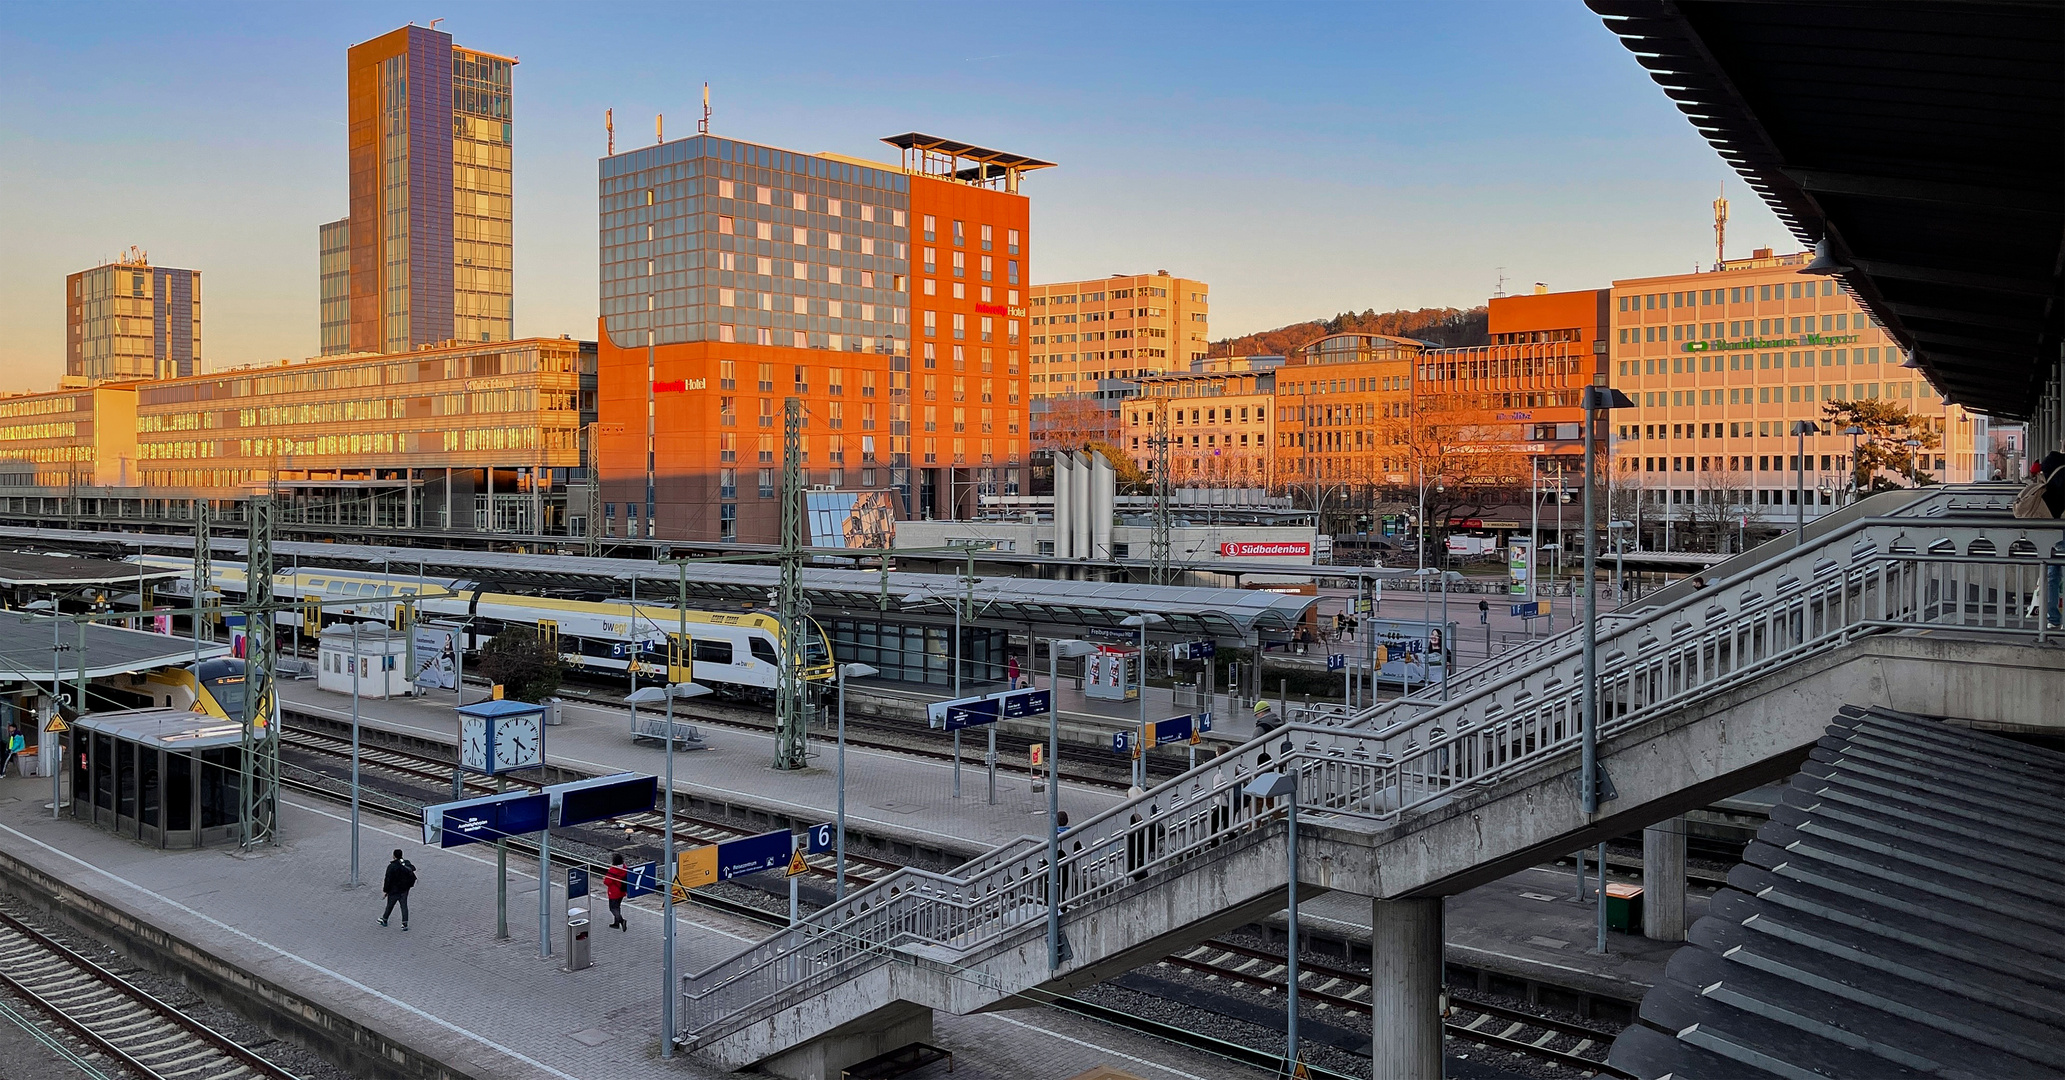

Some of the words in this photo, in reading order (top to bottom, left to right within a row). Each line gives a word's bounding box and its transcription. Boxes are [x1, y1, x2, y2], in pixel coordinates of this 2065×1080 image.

[1241, 544, 1306, 554] Südbadenbus
[602, 620, 627, 637] bwegt
[1090, 628, 1109, 637] Freiburg
[613, 643, 621, 655] 5
[647, 642, 654, 651] 4
[1329, 655, 1334, 668] 3
[1337, 654, 1342, 666] F
[1203, 713, 1211, 728] 4
[1116, 732, 1124, 749] 5
[818, 824, 830, 846] 6
[632, 866, 646, 891] 7
